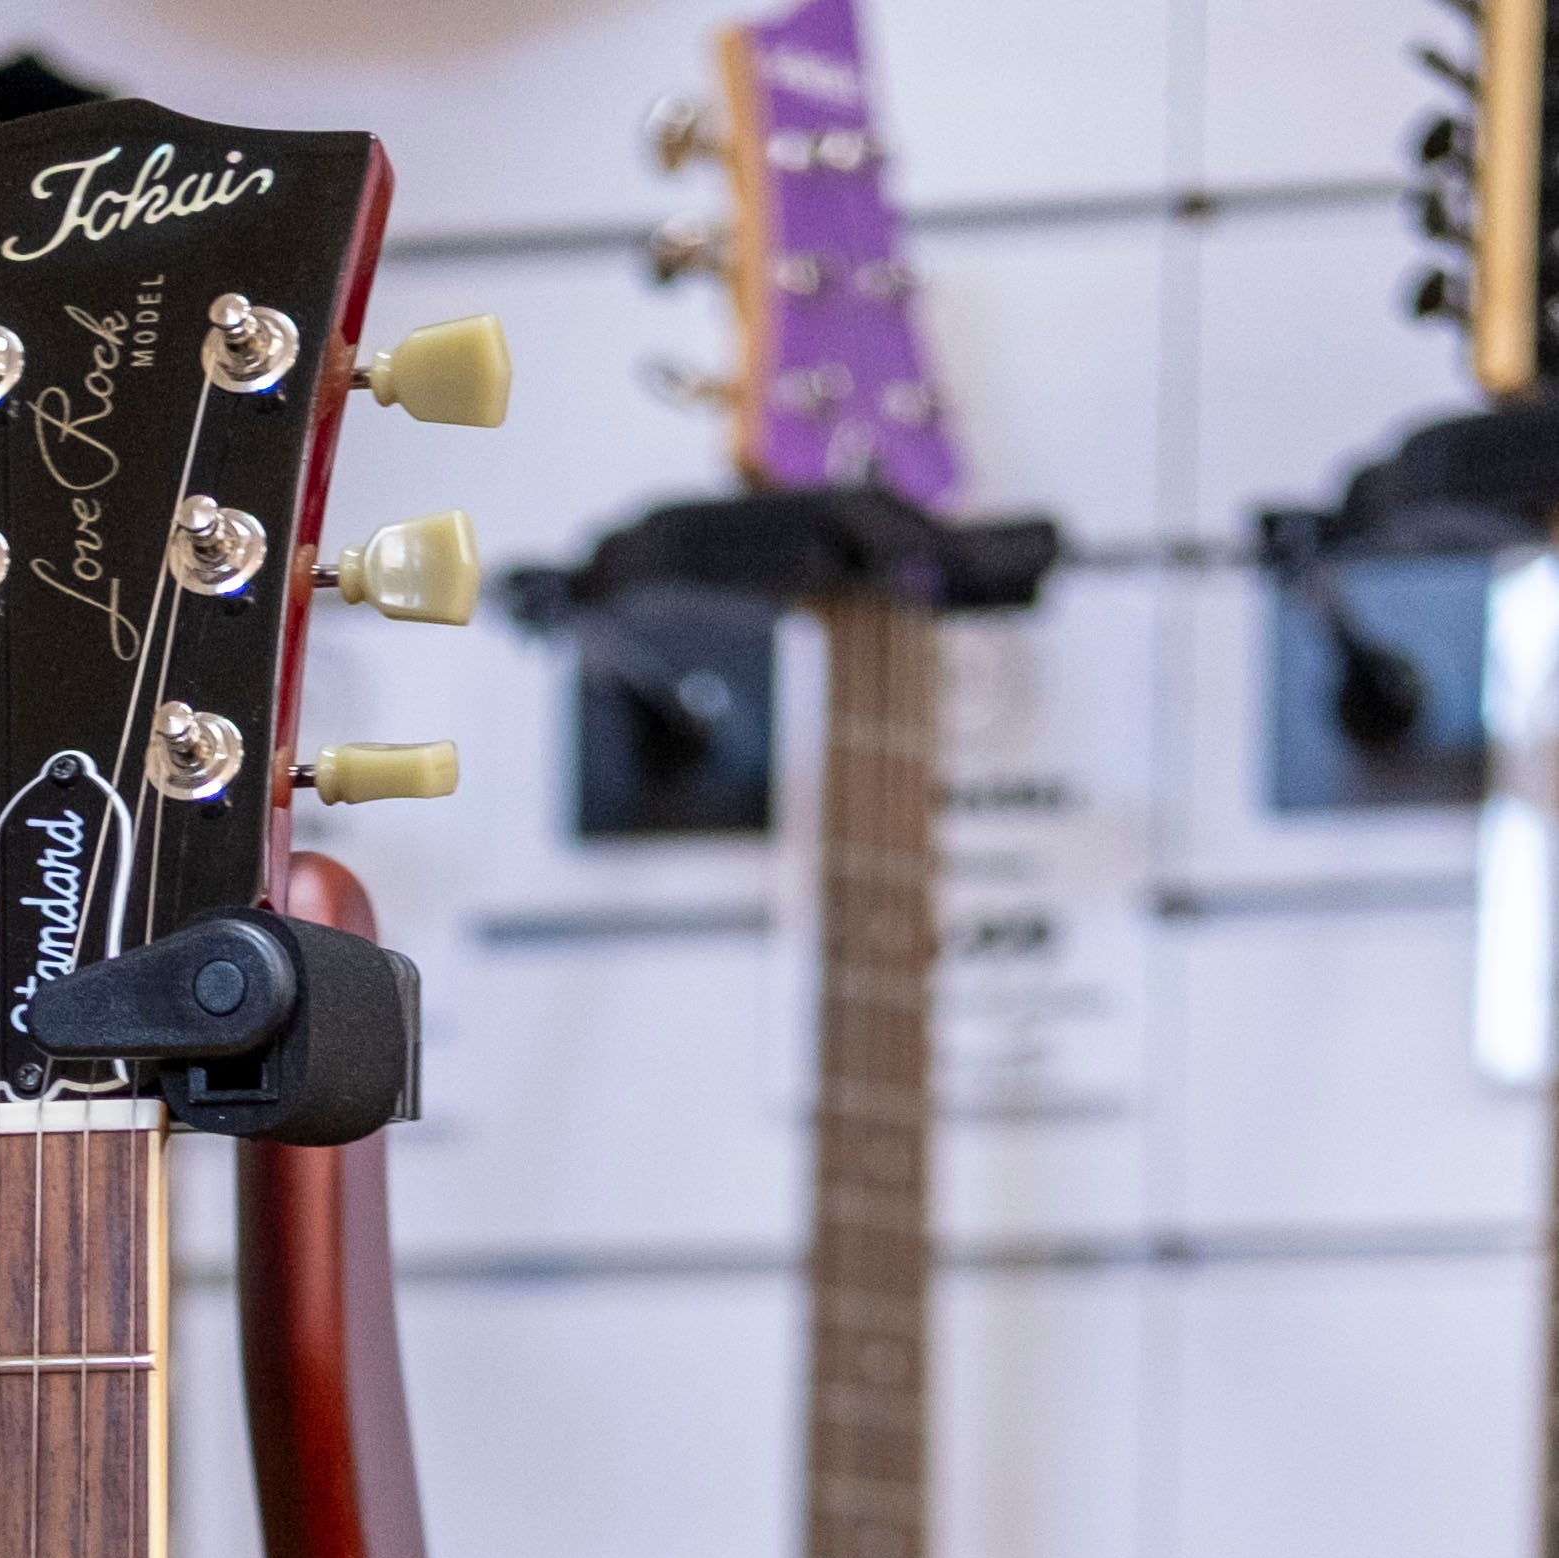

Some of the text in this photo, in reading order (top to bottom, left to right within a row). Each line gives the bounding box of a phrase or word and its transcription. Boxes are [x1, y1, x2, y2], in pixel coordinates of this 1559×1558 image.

[1, 142, 274, 262] Tokai
[130, 274, 164, 367] MODEL
[27, 304, 140, 661] Love Rock
